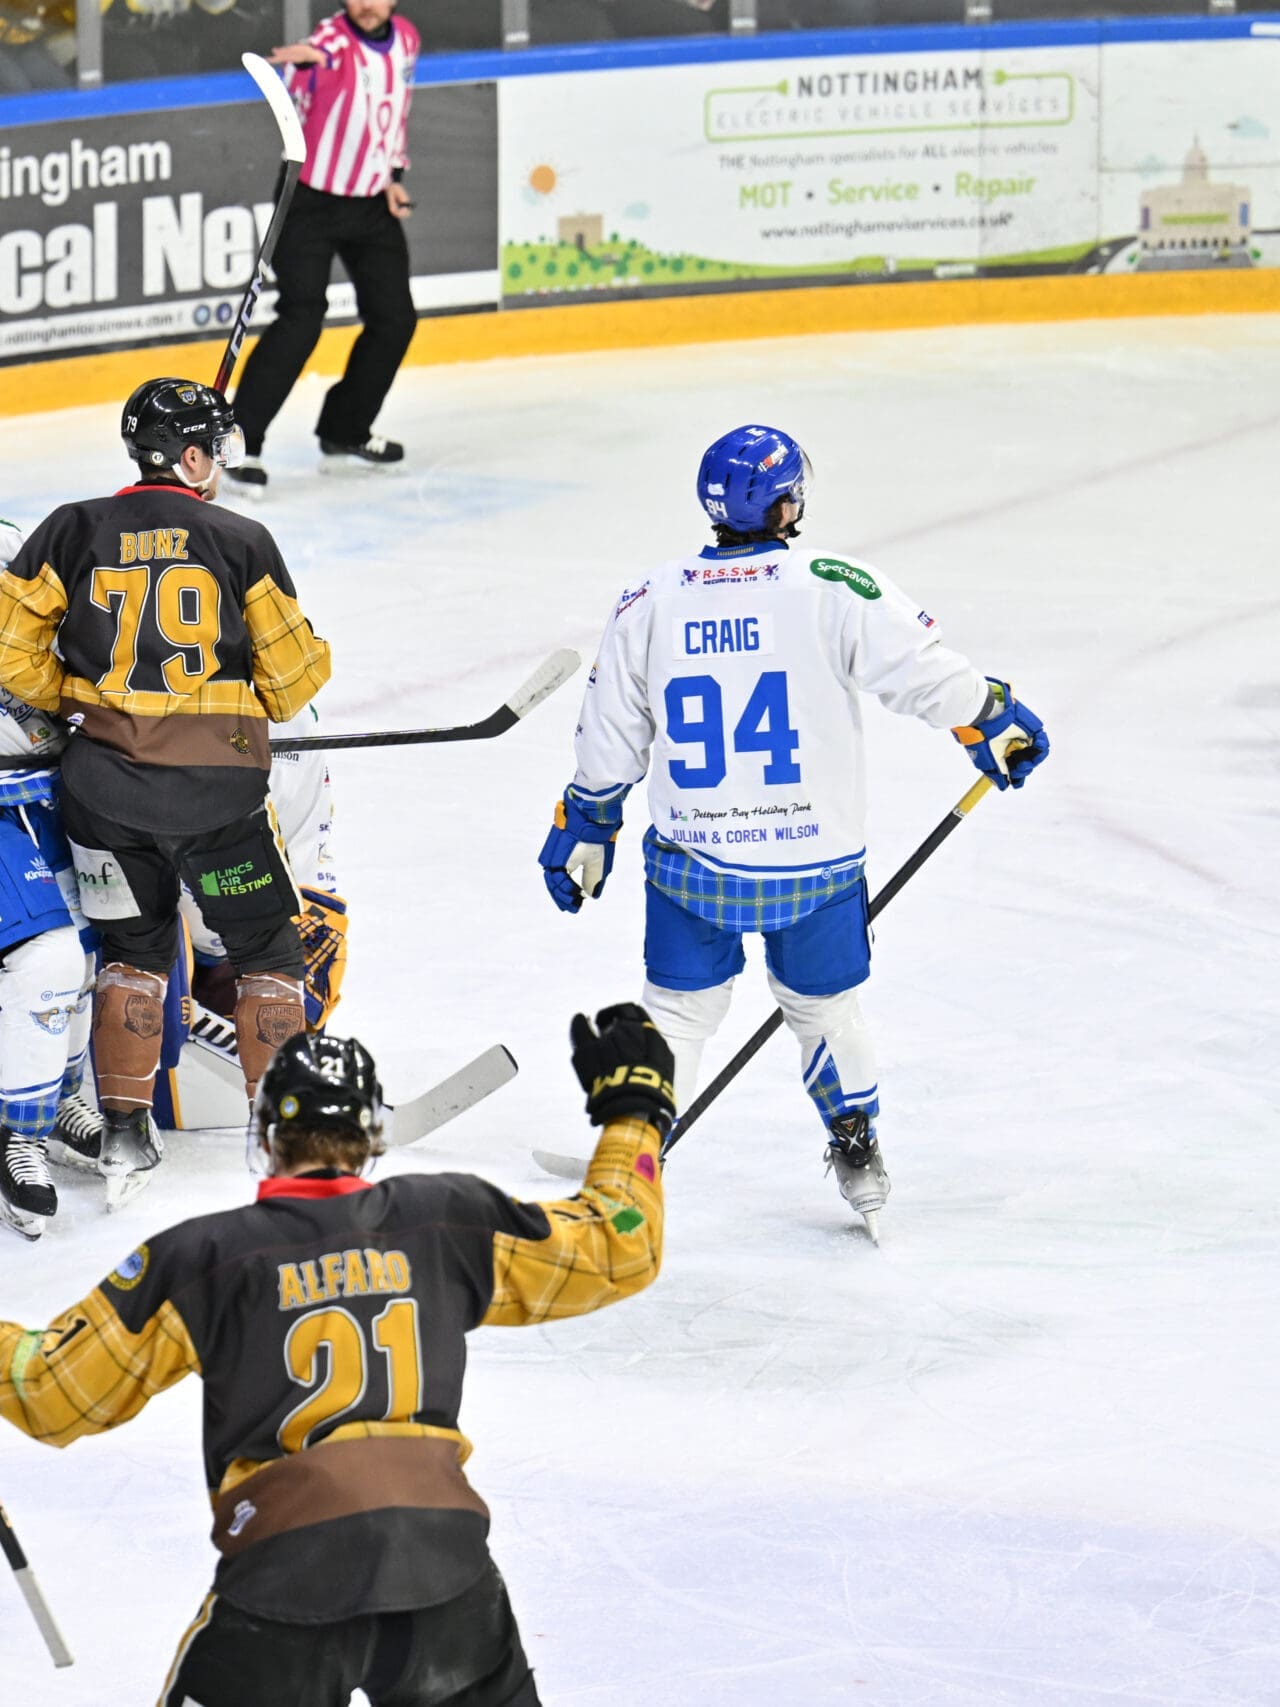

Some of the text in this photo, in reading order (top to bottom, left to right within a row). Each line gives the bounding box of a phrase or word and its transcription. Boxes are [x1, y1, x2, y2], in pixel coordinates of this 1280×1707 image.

[797, 68, 983, 98] NOTTINGHAM
[716, 95, 1061, 131] ELECTRIC VEHICLE SERVICES
[749, 150, 825, 169] Nottingham
[738, 171, 1037, 210] MOT Service Repair
[126, 415, 138, 433] 79
[182, 423, 207, 434] CCM
[705, 498, 728, 519] 94
[120, 527, 190, 564] BUNZ
[816, 561, 877, 593] Specsavers
[89, 564, 222, 697] 79
[684, 617, 760, 655] CRAIG
[664, 671, 802, 790] 94
[729, 807, 750, 819] Bay
[790, 801, 812, 815] Park
[670, 823, 820, 844] JULIAN & COREN WILSON
[216, 860, 254, 879] LINCS
[219, 876, 242, 887] AIR
[220, 872, 273, 896] TESTING
[320, 1055, 345, 1078] 21
[278, 1247, 412, 1311] ALFARO
[277, 1297, 422, 1458] 21
